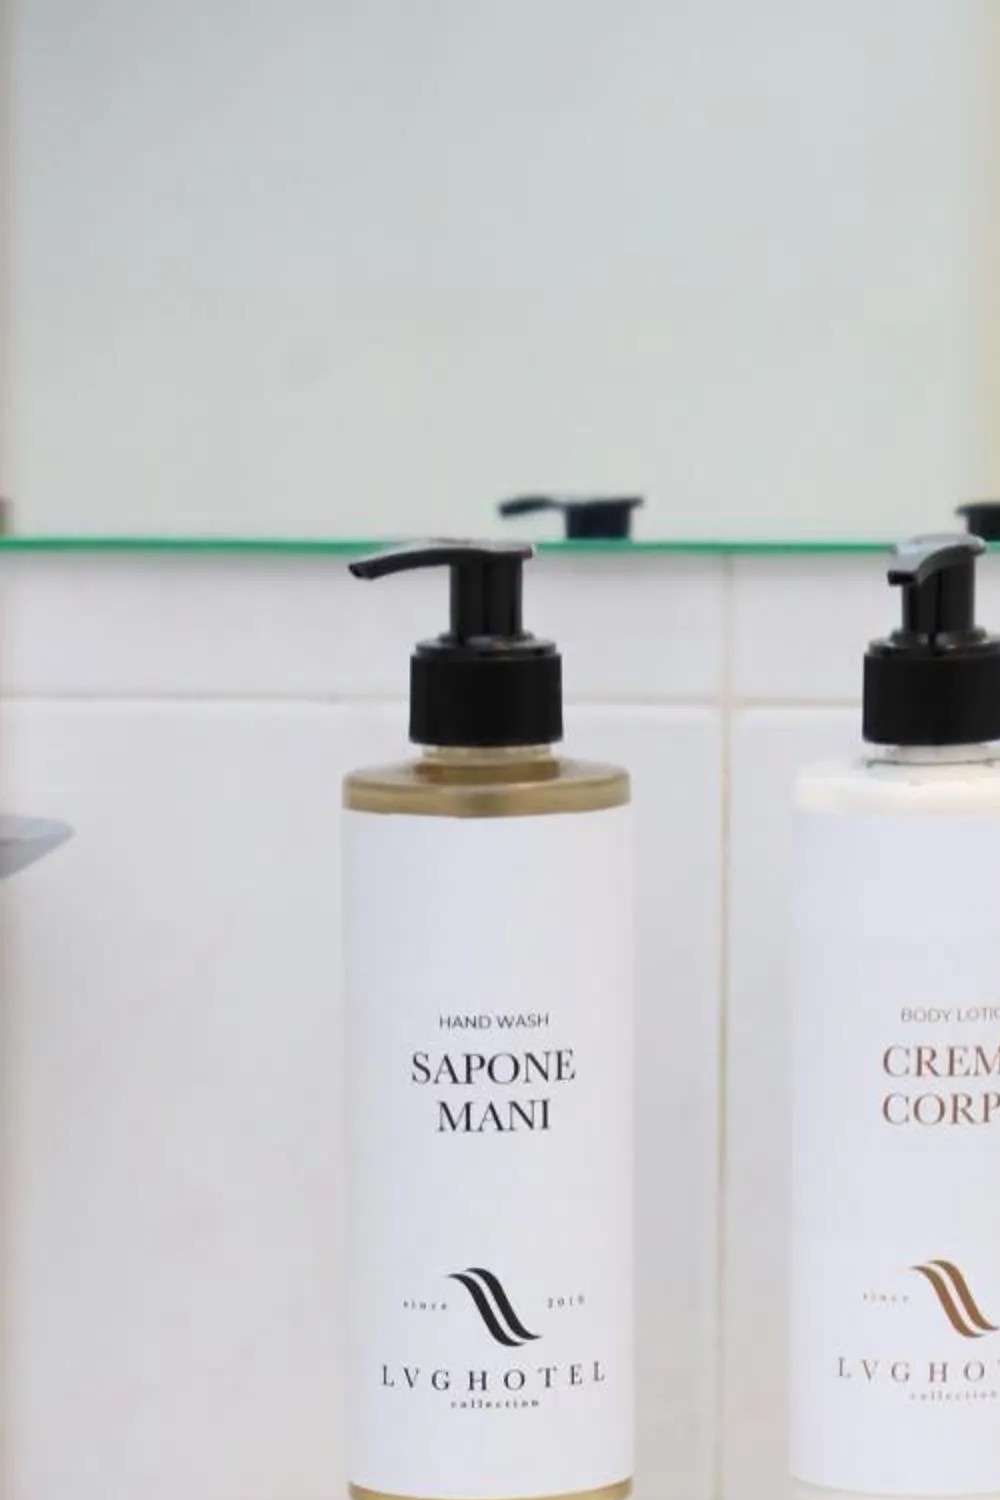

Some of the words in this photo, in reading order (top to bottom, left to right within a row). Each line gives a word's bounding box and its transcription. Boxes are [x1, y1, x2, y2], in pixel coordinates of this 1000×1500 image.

[438, 1014, 492, 1031] HAND
[495, 1012, 550, 1030] WASH
[900, 1007, 951, 1024] BODY
[411, 1047, 577, 1086] SAPONE
[436, 1098, 552, 1133] MANI
[449, 1397, 540, 1409] collection
